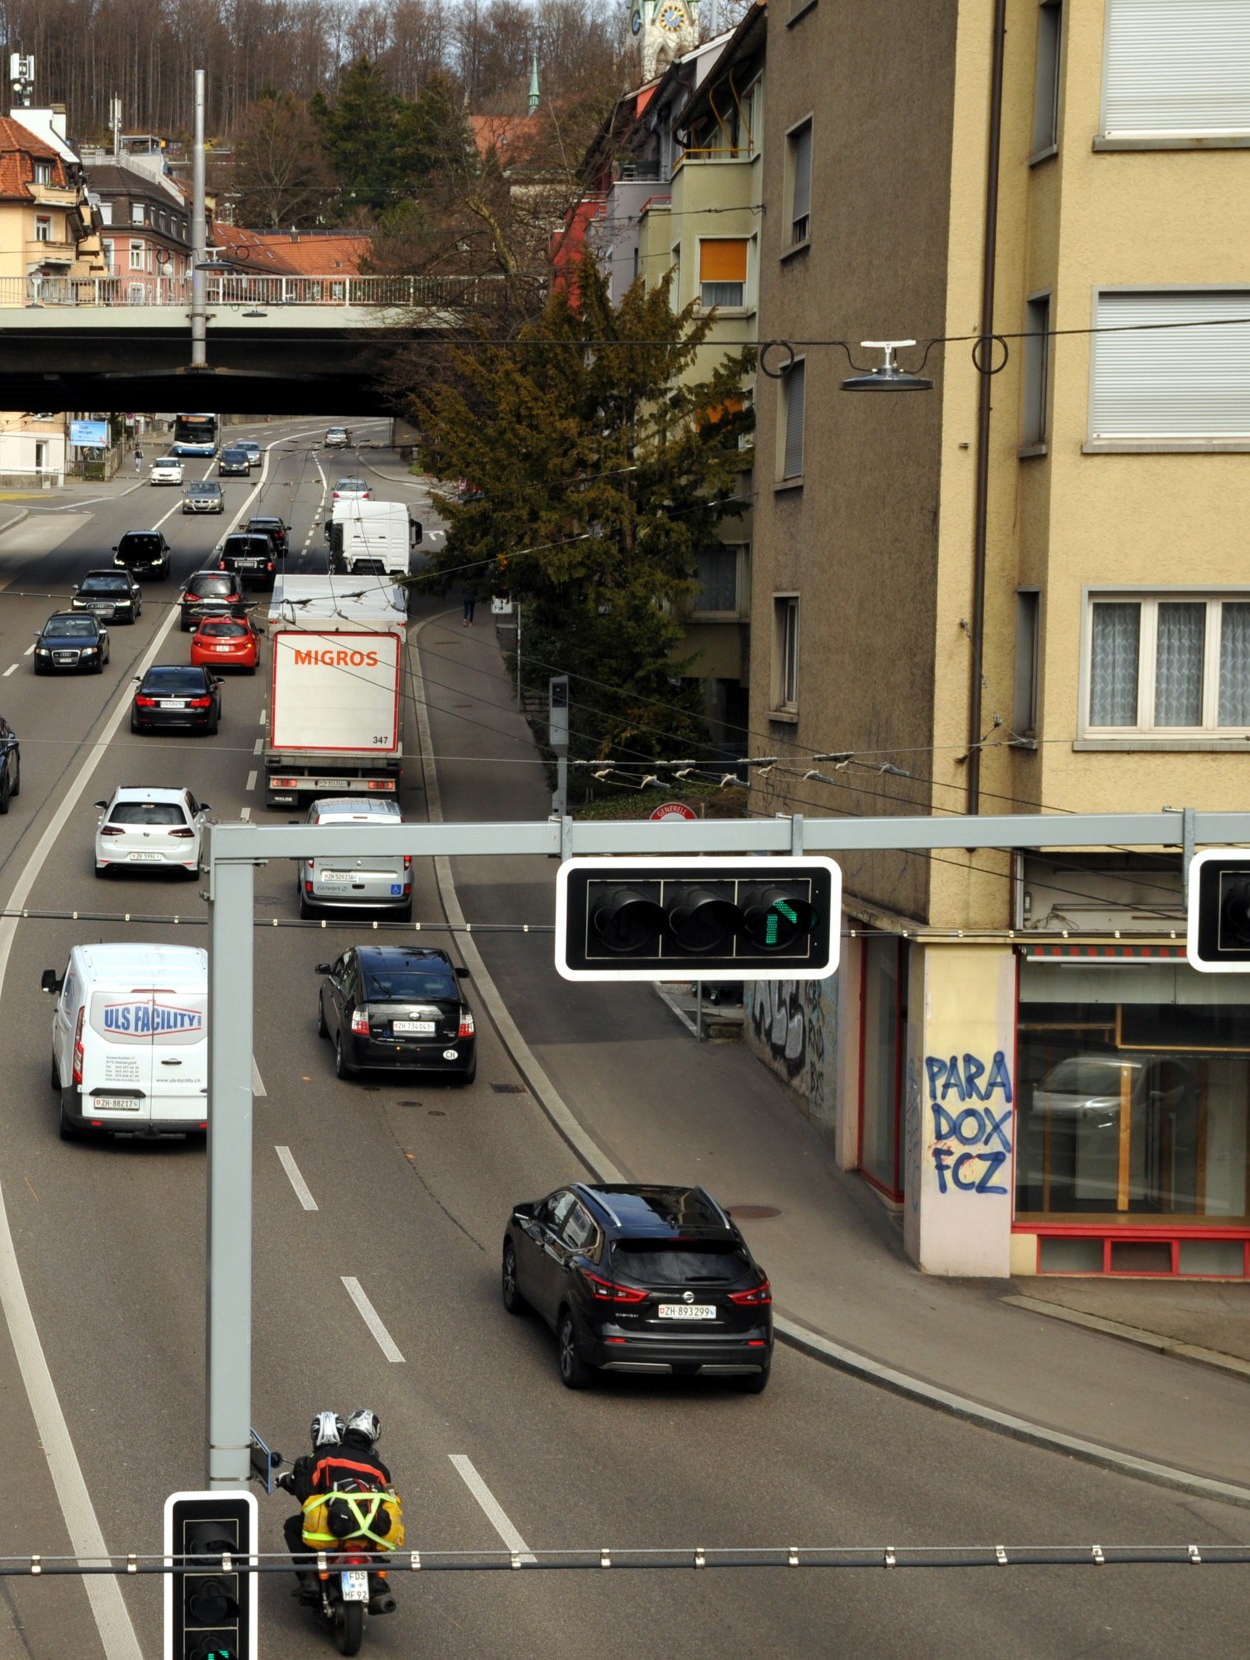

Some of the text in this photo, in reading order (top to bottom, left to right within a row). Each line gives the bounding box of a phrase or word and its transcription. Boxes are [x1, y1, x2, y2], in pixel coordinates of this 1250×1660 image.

[294, 650, 379, 667] MIGROS
[373, 736, 388, 745] 347
[656, 805, 687, 817] GENERELL
[104, 1007, 130, 1031] ULS
[134, 1006, 196, 1033] FACILITY
[445, 1051, 455, 1059] CH
[925, 1051, 1012, 1103] PARA
[931, 1103, 1013, 1153] DOX
[933, 1147, 1008, 1195] FCZ
[349, 1571, 366, 1580] FDS
